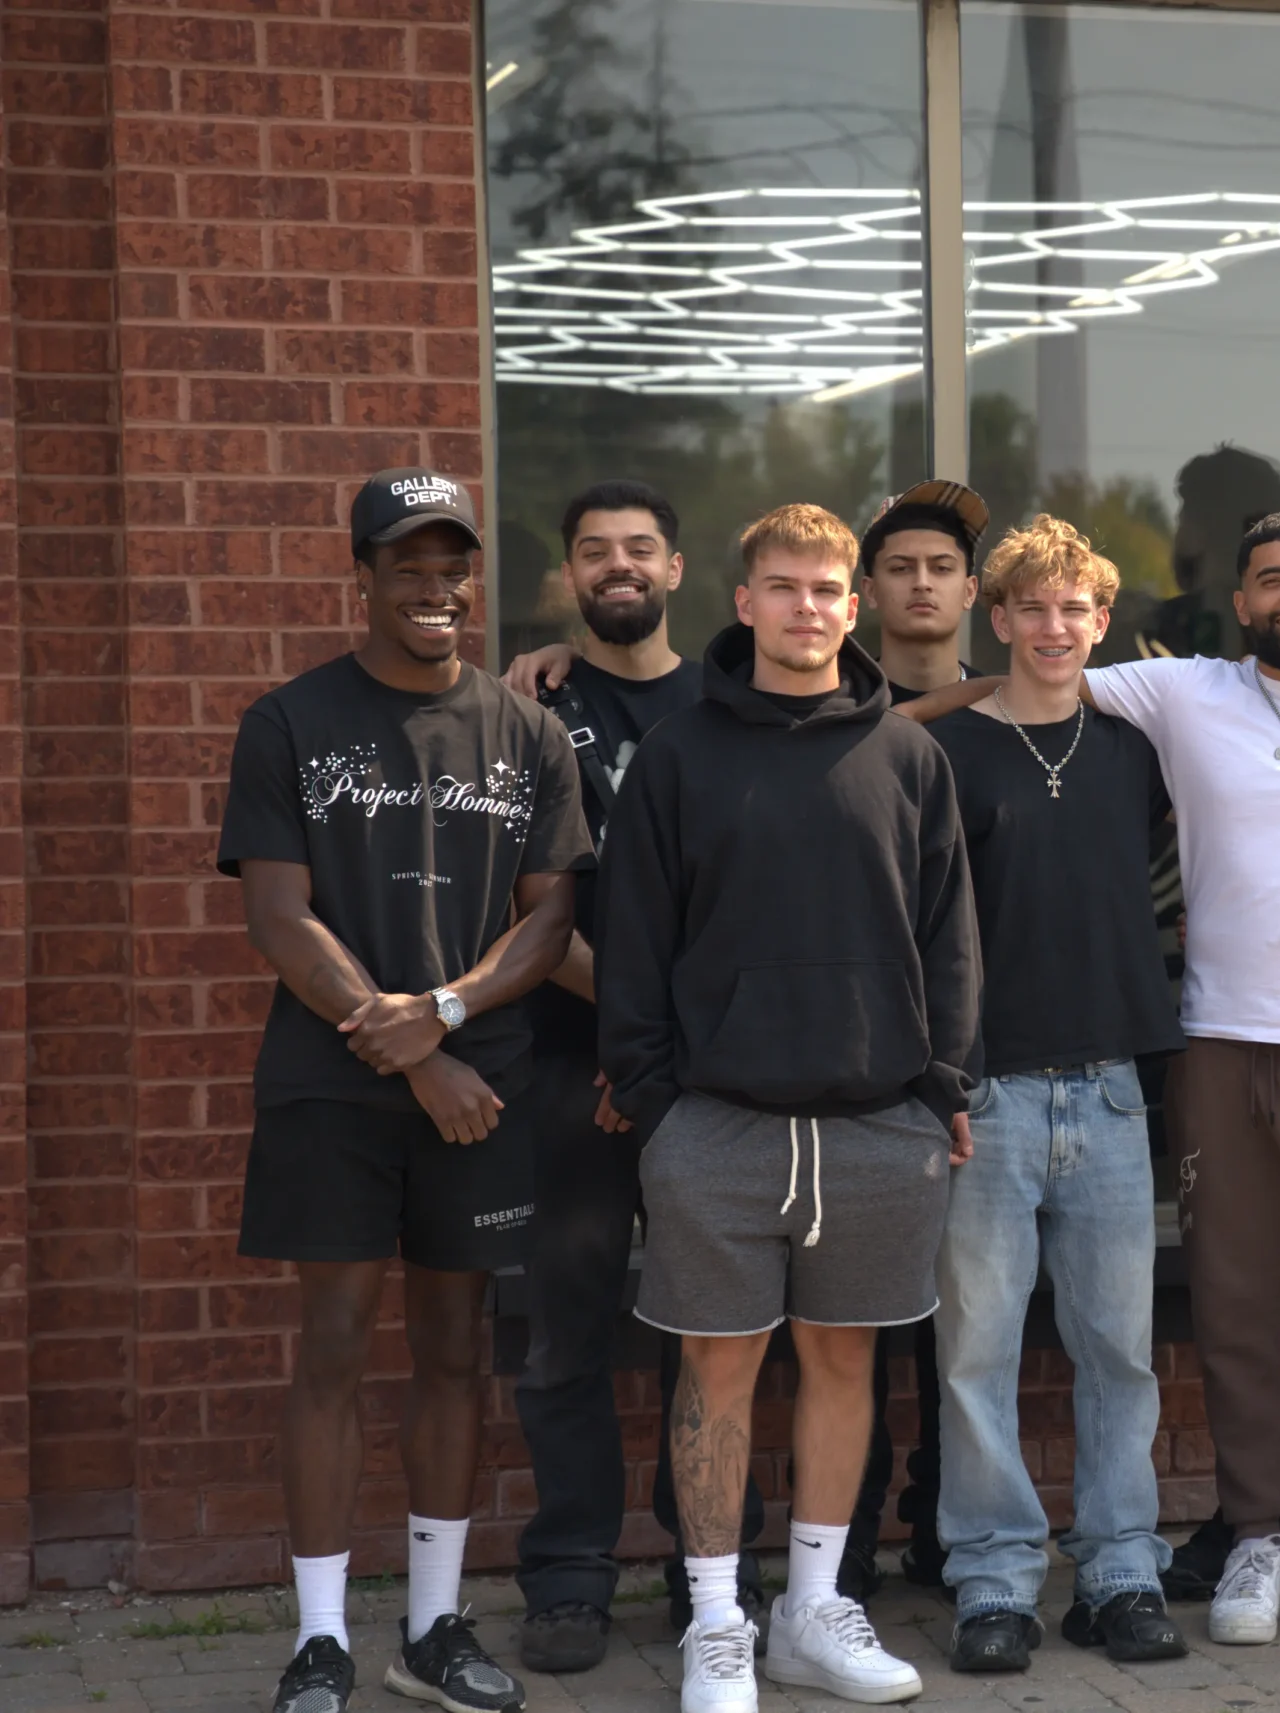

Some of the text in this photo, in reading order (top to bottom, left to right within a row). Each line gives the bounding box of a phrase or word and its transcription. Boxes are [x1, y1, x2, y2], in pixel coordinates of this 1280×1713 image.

[390, 476, 458, 496] GALLERY
[404, 490, 456, 507] DEPT.
[312, 771, 525, 822] Project Homme
[391, 871, 420, 880] SPRING
[1161, 1633, 1175, 1643] 42
[984, 1644, 999, 1656] 42
